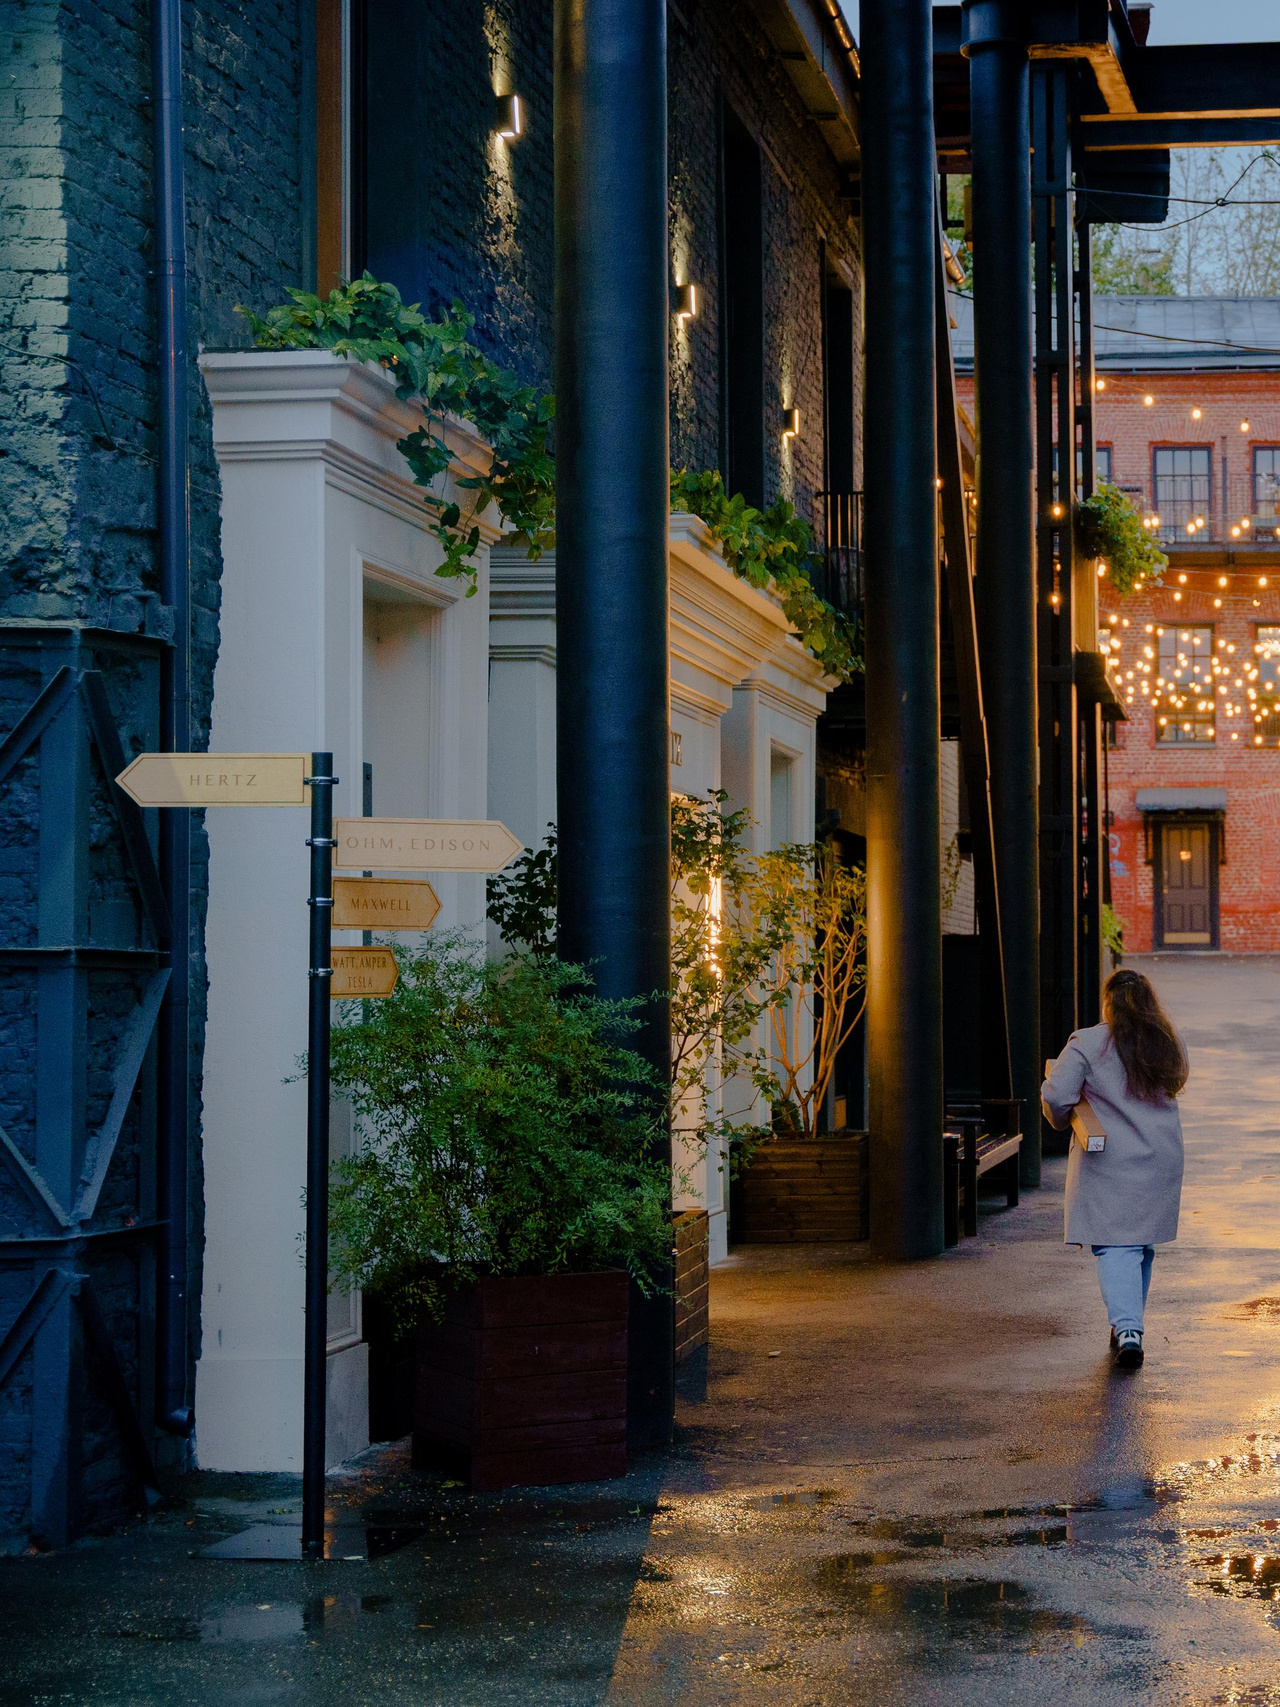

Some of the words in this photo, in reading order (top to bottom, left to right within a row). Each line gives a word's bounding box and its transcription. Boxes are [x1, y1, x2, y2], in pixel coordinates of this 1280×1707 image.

[190, 774, 257, 786] HERTZ
[346, 836, 401, 852] OHM,
[411, 838, 490, 851] EDISON
[351, 898, 411, 911] MAXWELL
[360, 956, 387, 968] AMPER
[348, 976, 373, 988] TESLA
